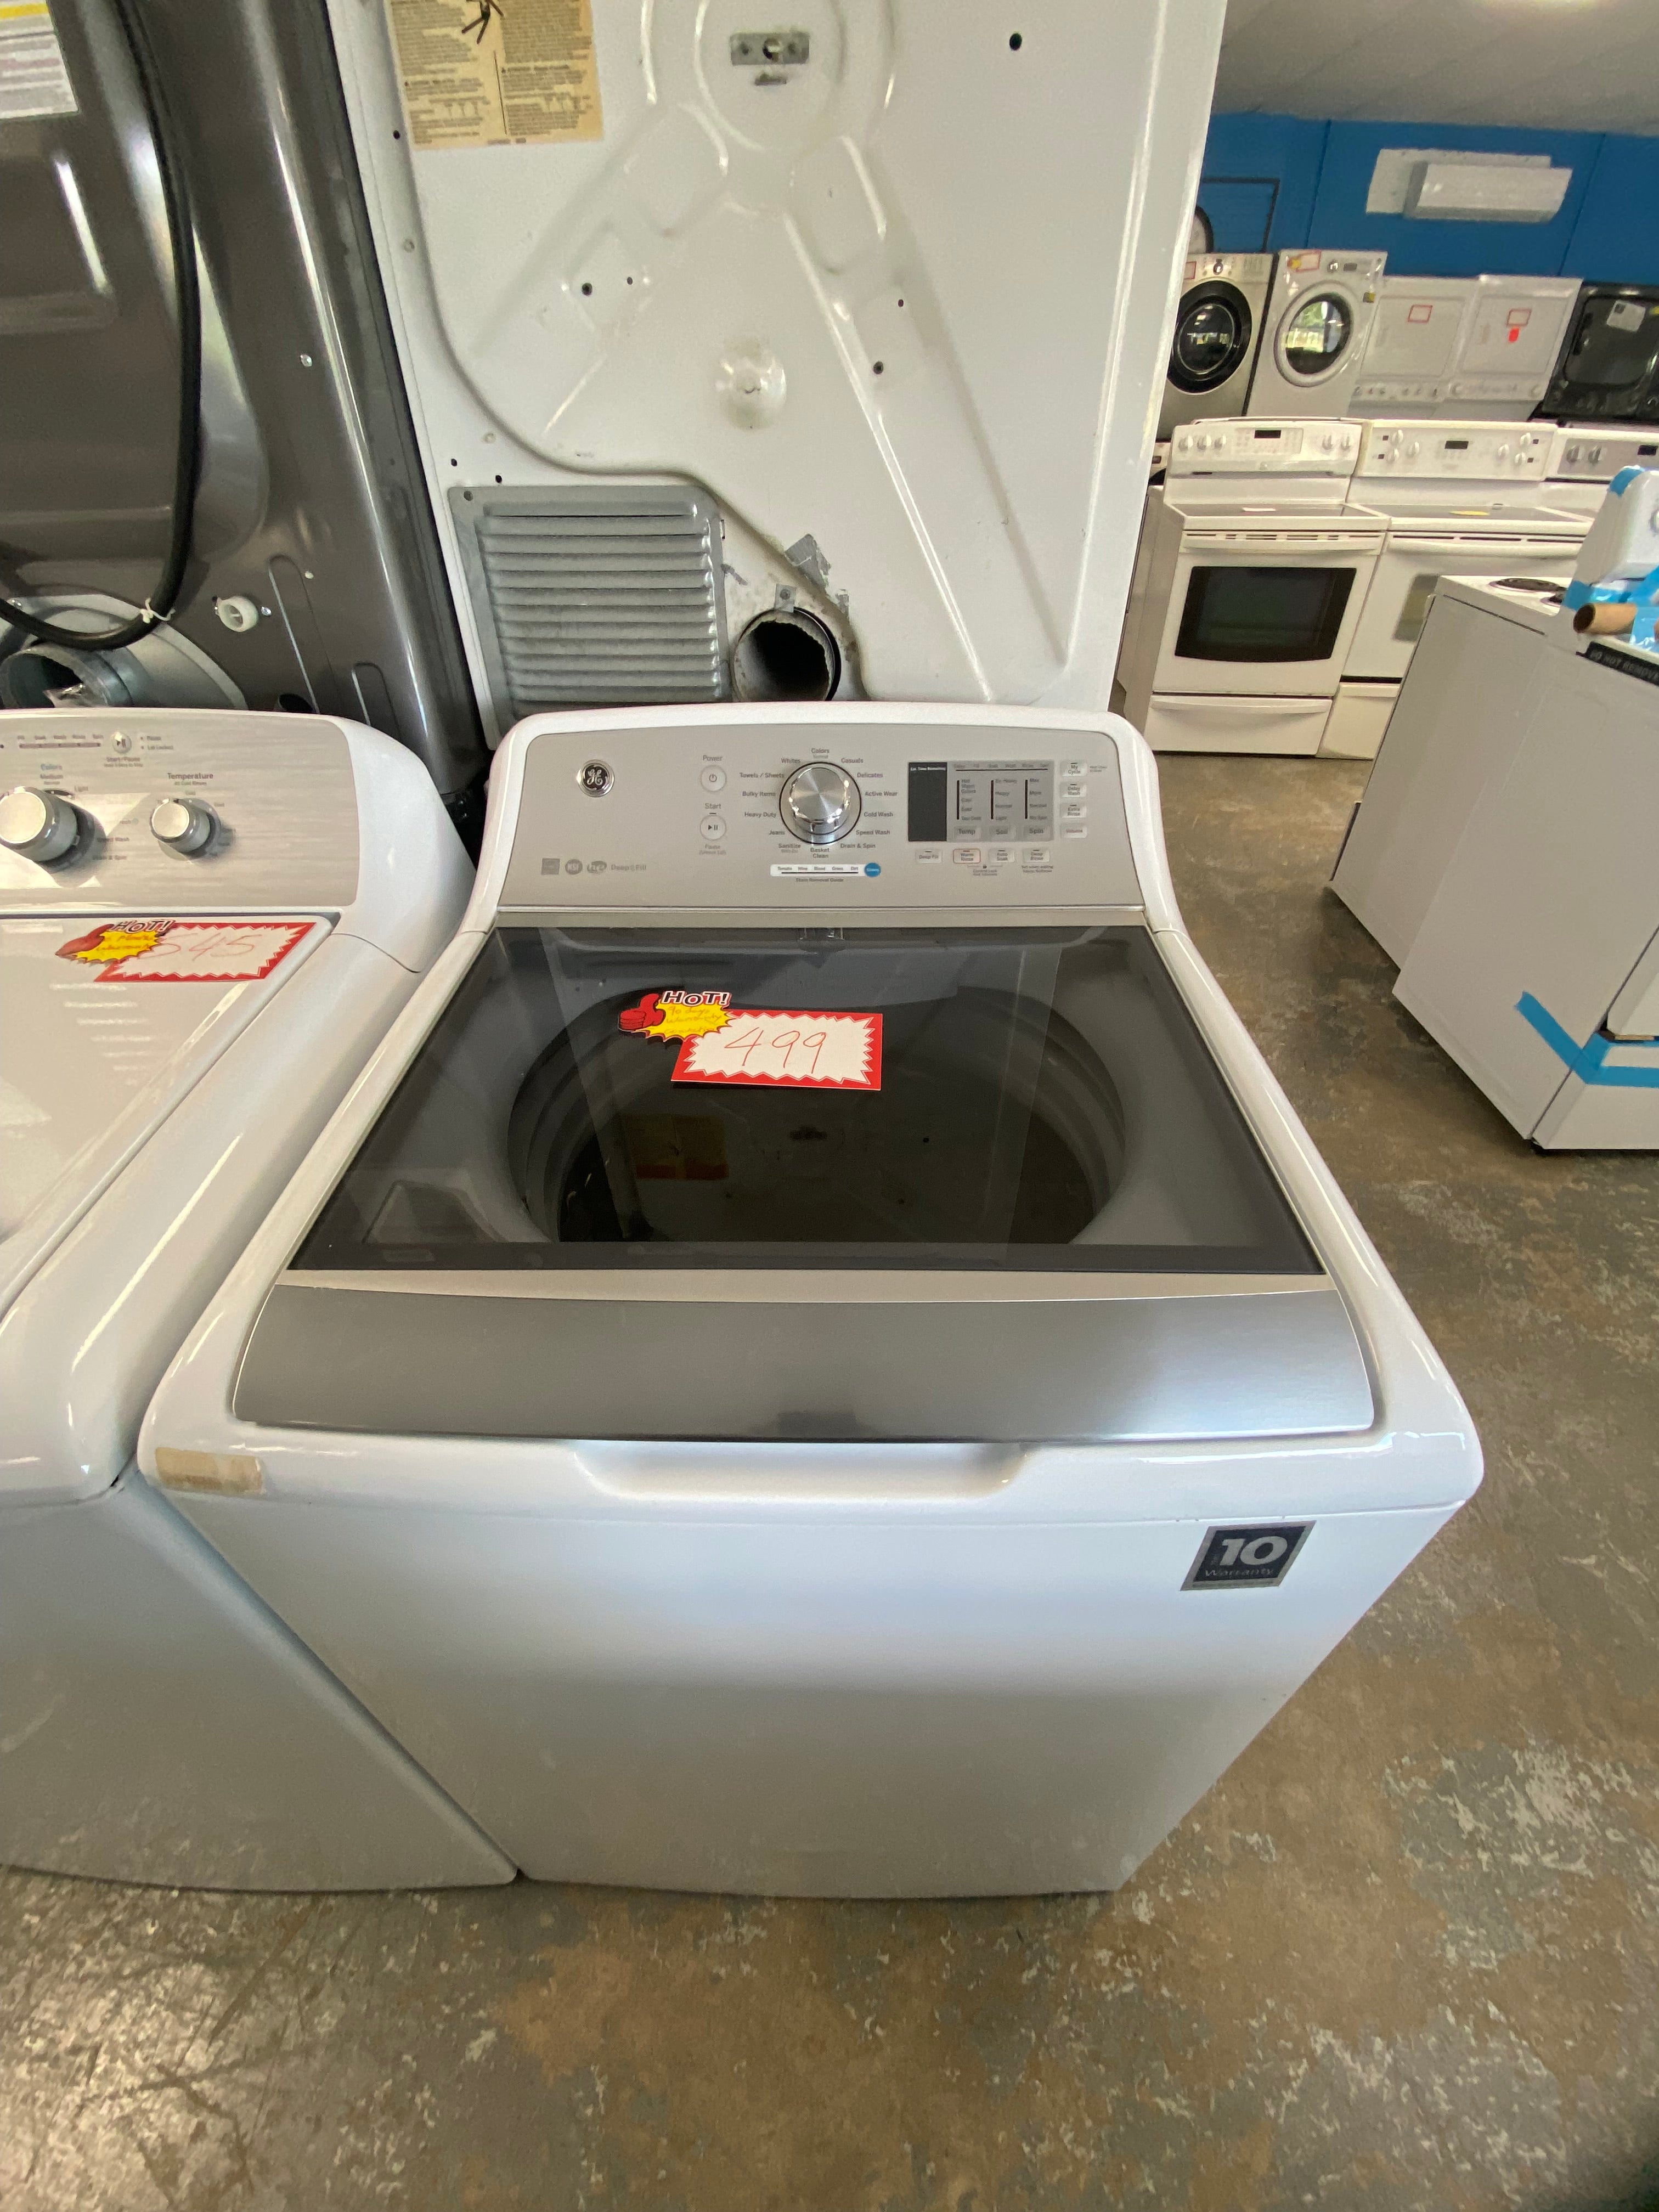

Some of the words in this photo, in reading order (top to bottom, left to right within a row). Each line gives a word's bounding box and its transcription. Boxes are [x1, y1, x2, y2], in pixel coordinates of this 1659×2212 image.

[111, 919, 174, 933] HOT!
[662, 991, 730, 1006] HOT!
[724, 1026, 827, 1074] 499
[1219, 1536, 1288, 1566] 10
